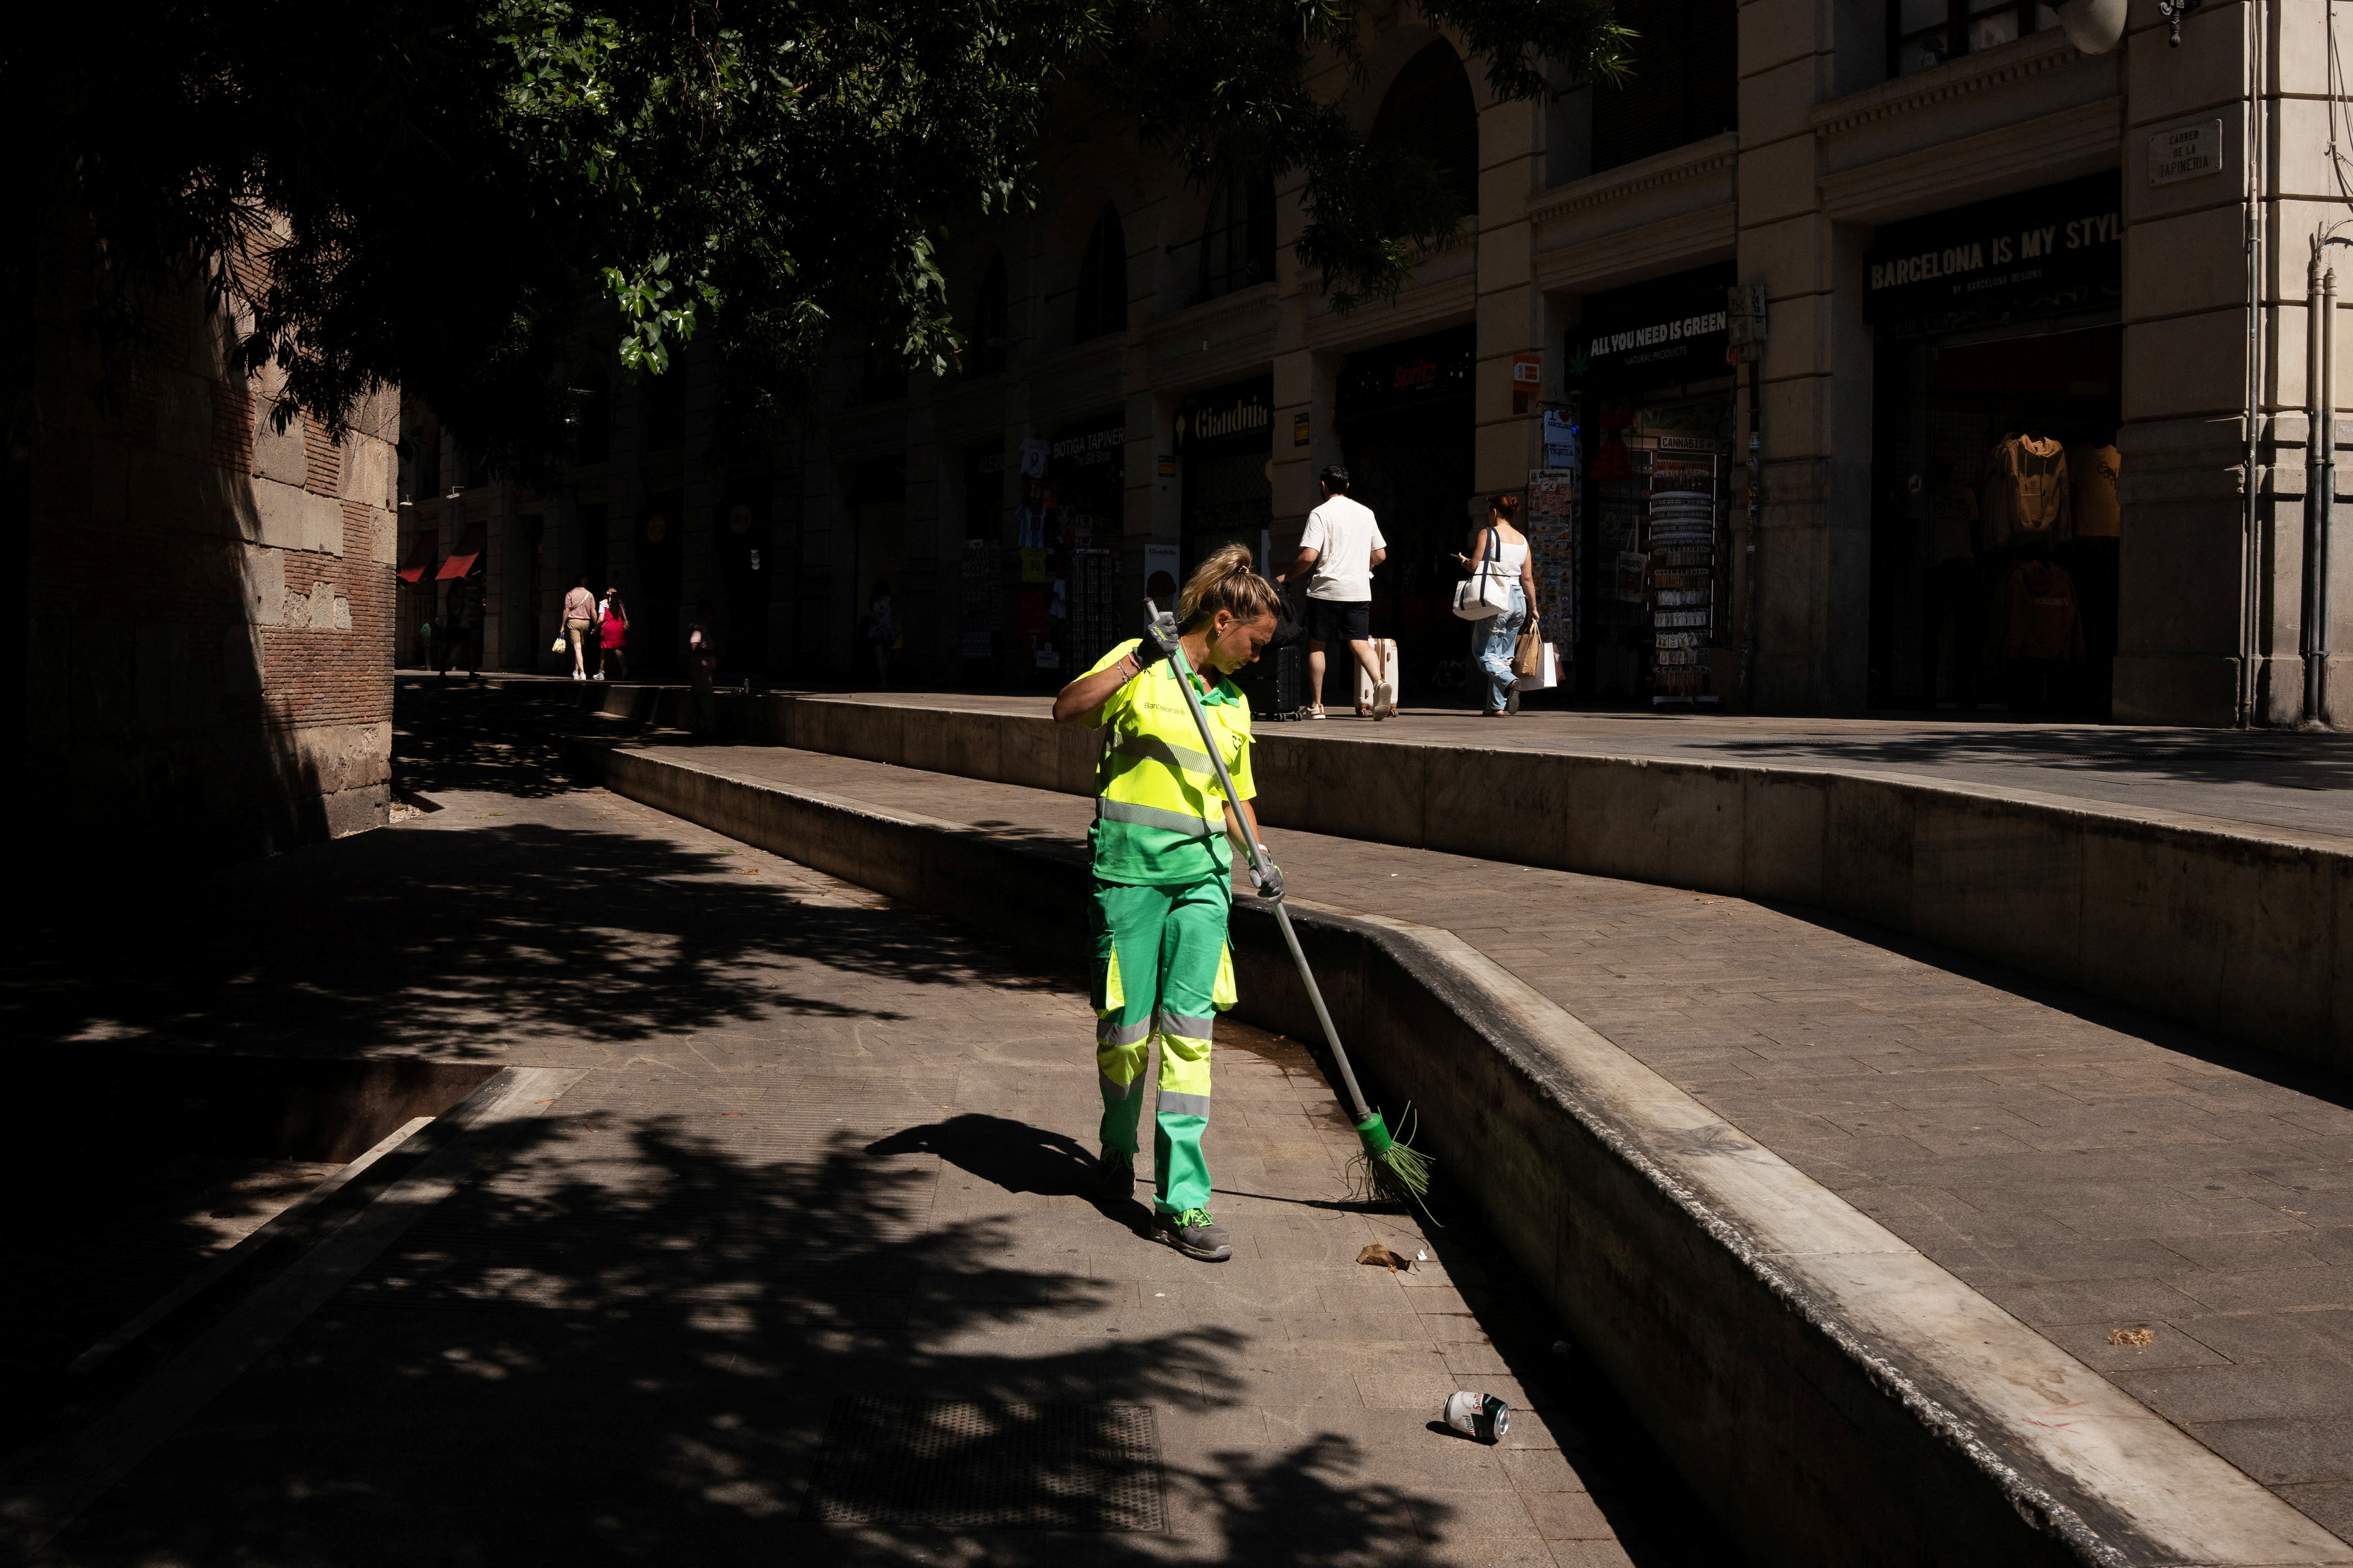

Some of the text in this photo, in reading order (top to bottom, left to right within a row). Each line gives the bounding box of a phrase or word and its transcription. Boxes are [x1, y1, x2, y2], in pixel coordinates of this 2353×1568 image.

[2169, 130, 2198, 145] CARRER
[2174, 145, 2195, 158] DE LA
[2160, 155, 2208, 177] TAPINERIA
[1871, 242, 1984, 290] BARCELONA
[1992, 236, 2012, 265] IS
[2022, 226, 2056, 259] MY
[1953, 268, 2043, 294] BY BARCELONA DESIGNS
[1590, 311, 1726, 357] ALL YOU NEED IS GREEN
[1624, 346, 1687, 366] NATURAL PRODUCTS
[1547, 421, 1572, 430] BARCELONA
[1054, 427, 1125, 459] BOTIGA TAPINER
[1663, 437, 1704, 449] CANNABIS
[1031, 452, 1039, 467] 9
[1074, 451, 1111, 467] The Gift Shop
[1549, 447, 1574, 457] TEQUILA
[1539, 470, 1568, 479] Barcelona
[1031, 516, 1041, 531] 10
[1144, 702, 1179, 714] Barcelona
